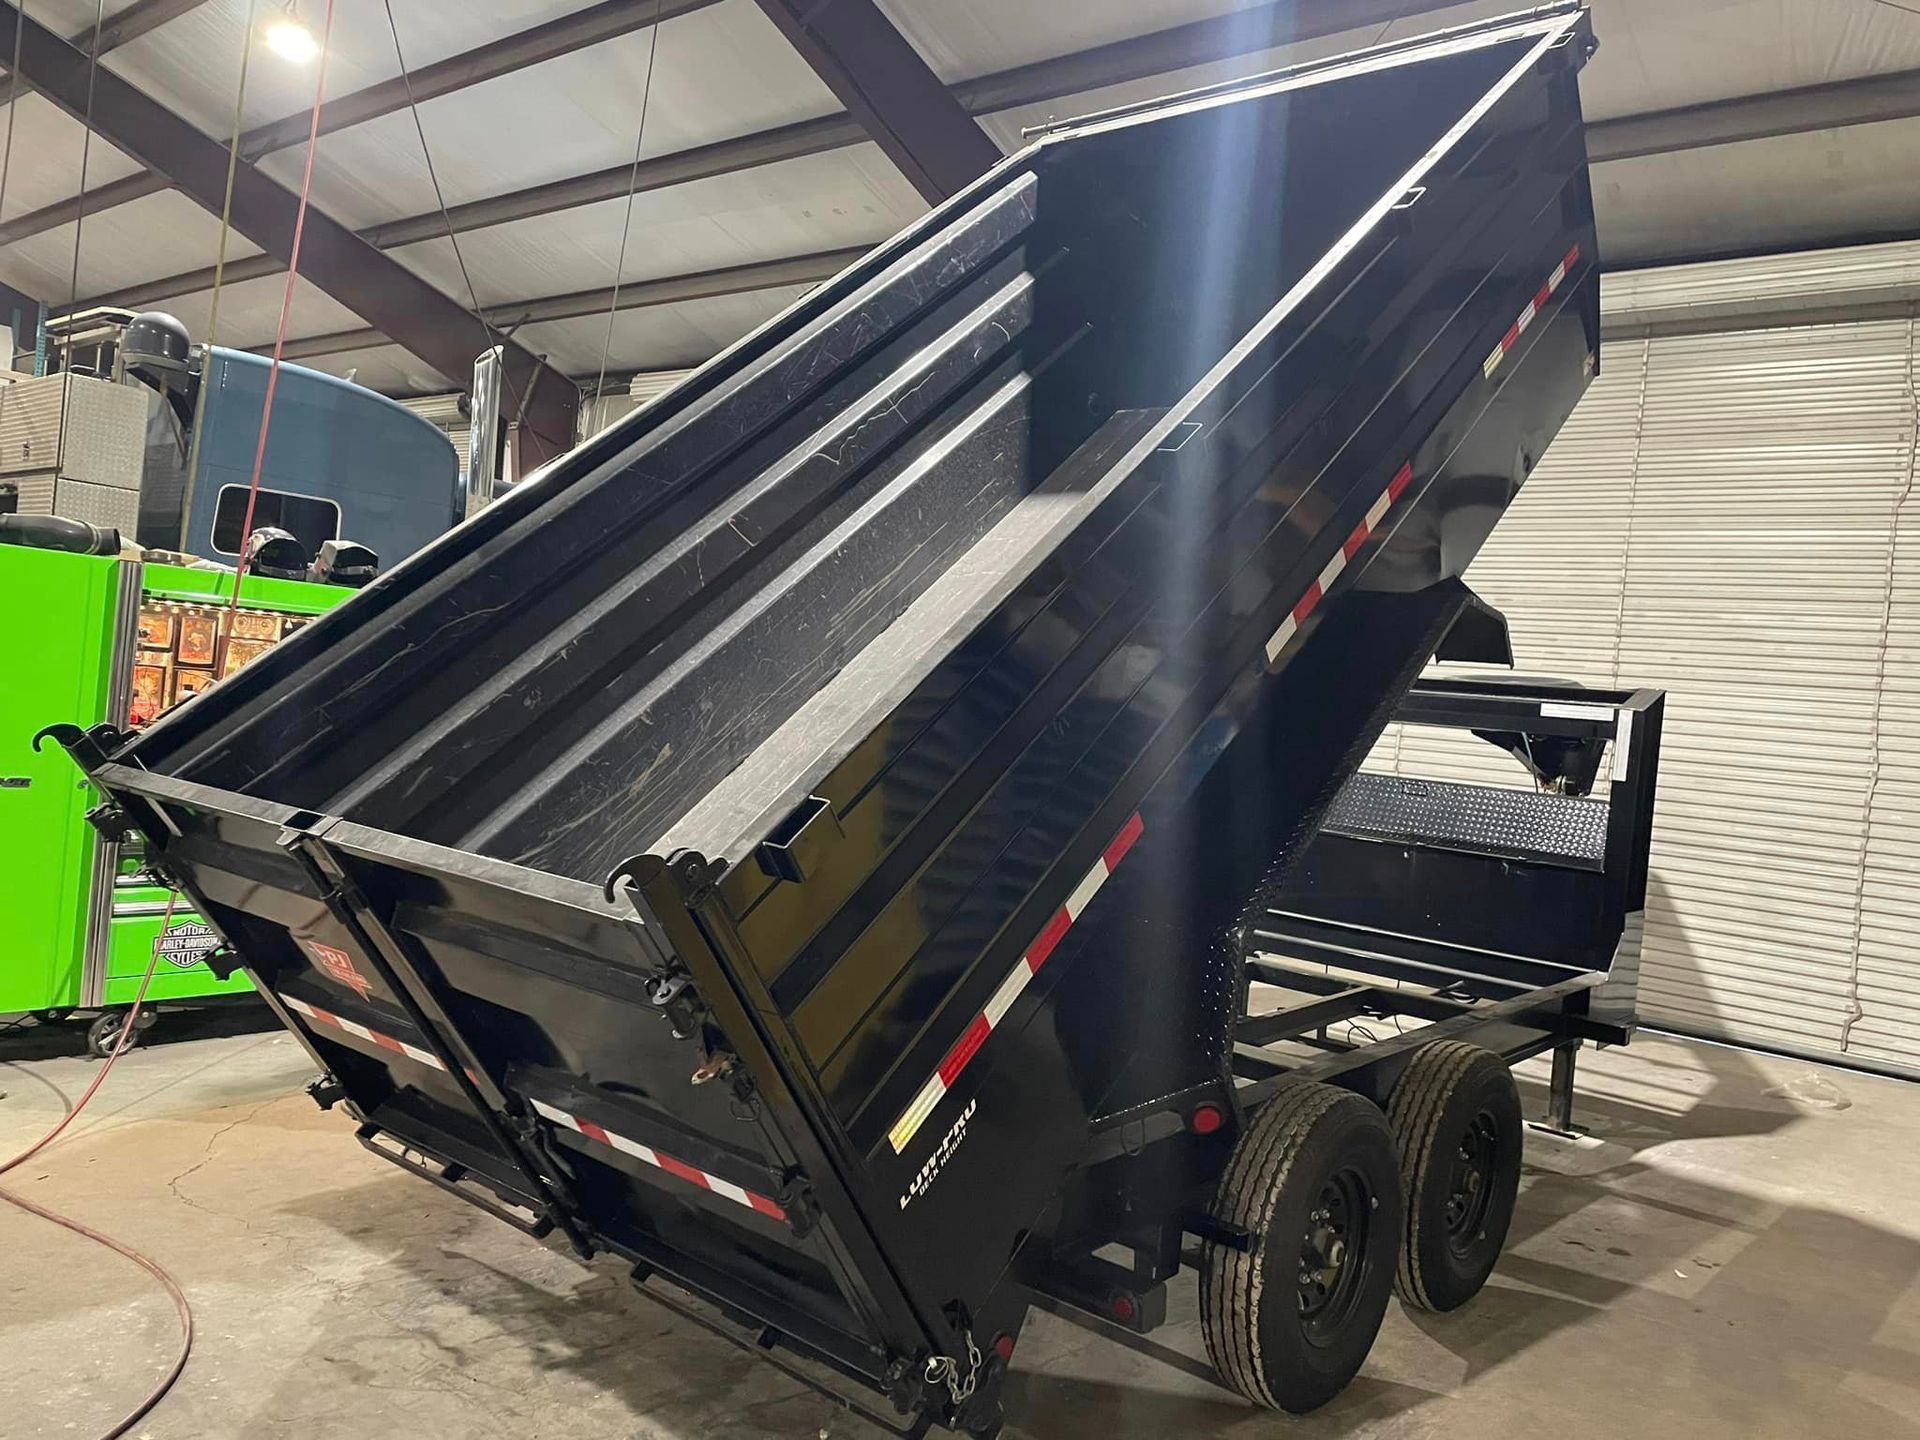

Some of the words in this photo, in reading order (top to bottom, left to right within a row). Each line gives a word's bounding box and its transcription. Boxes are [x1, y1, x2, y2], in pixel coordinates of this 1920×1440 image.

[173, 924, 206, 936] MOTOR
[919, 1167, 939, 1196] DECK
[940, 1127, 967, 1167] HEIGHT
